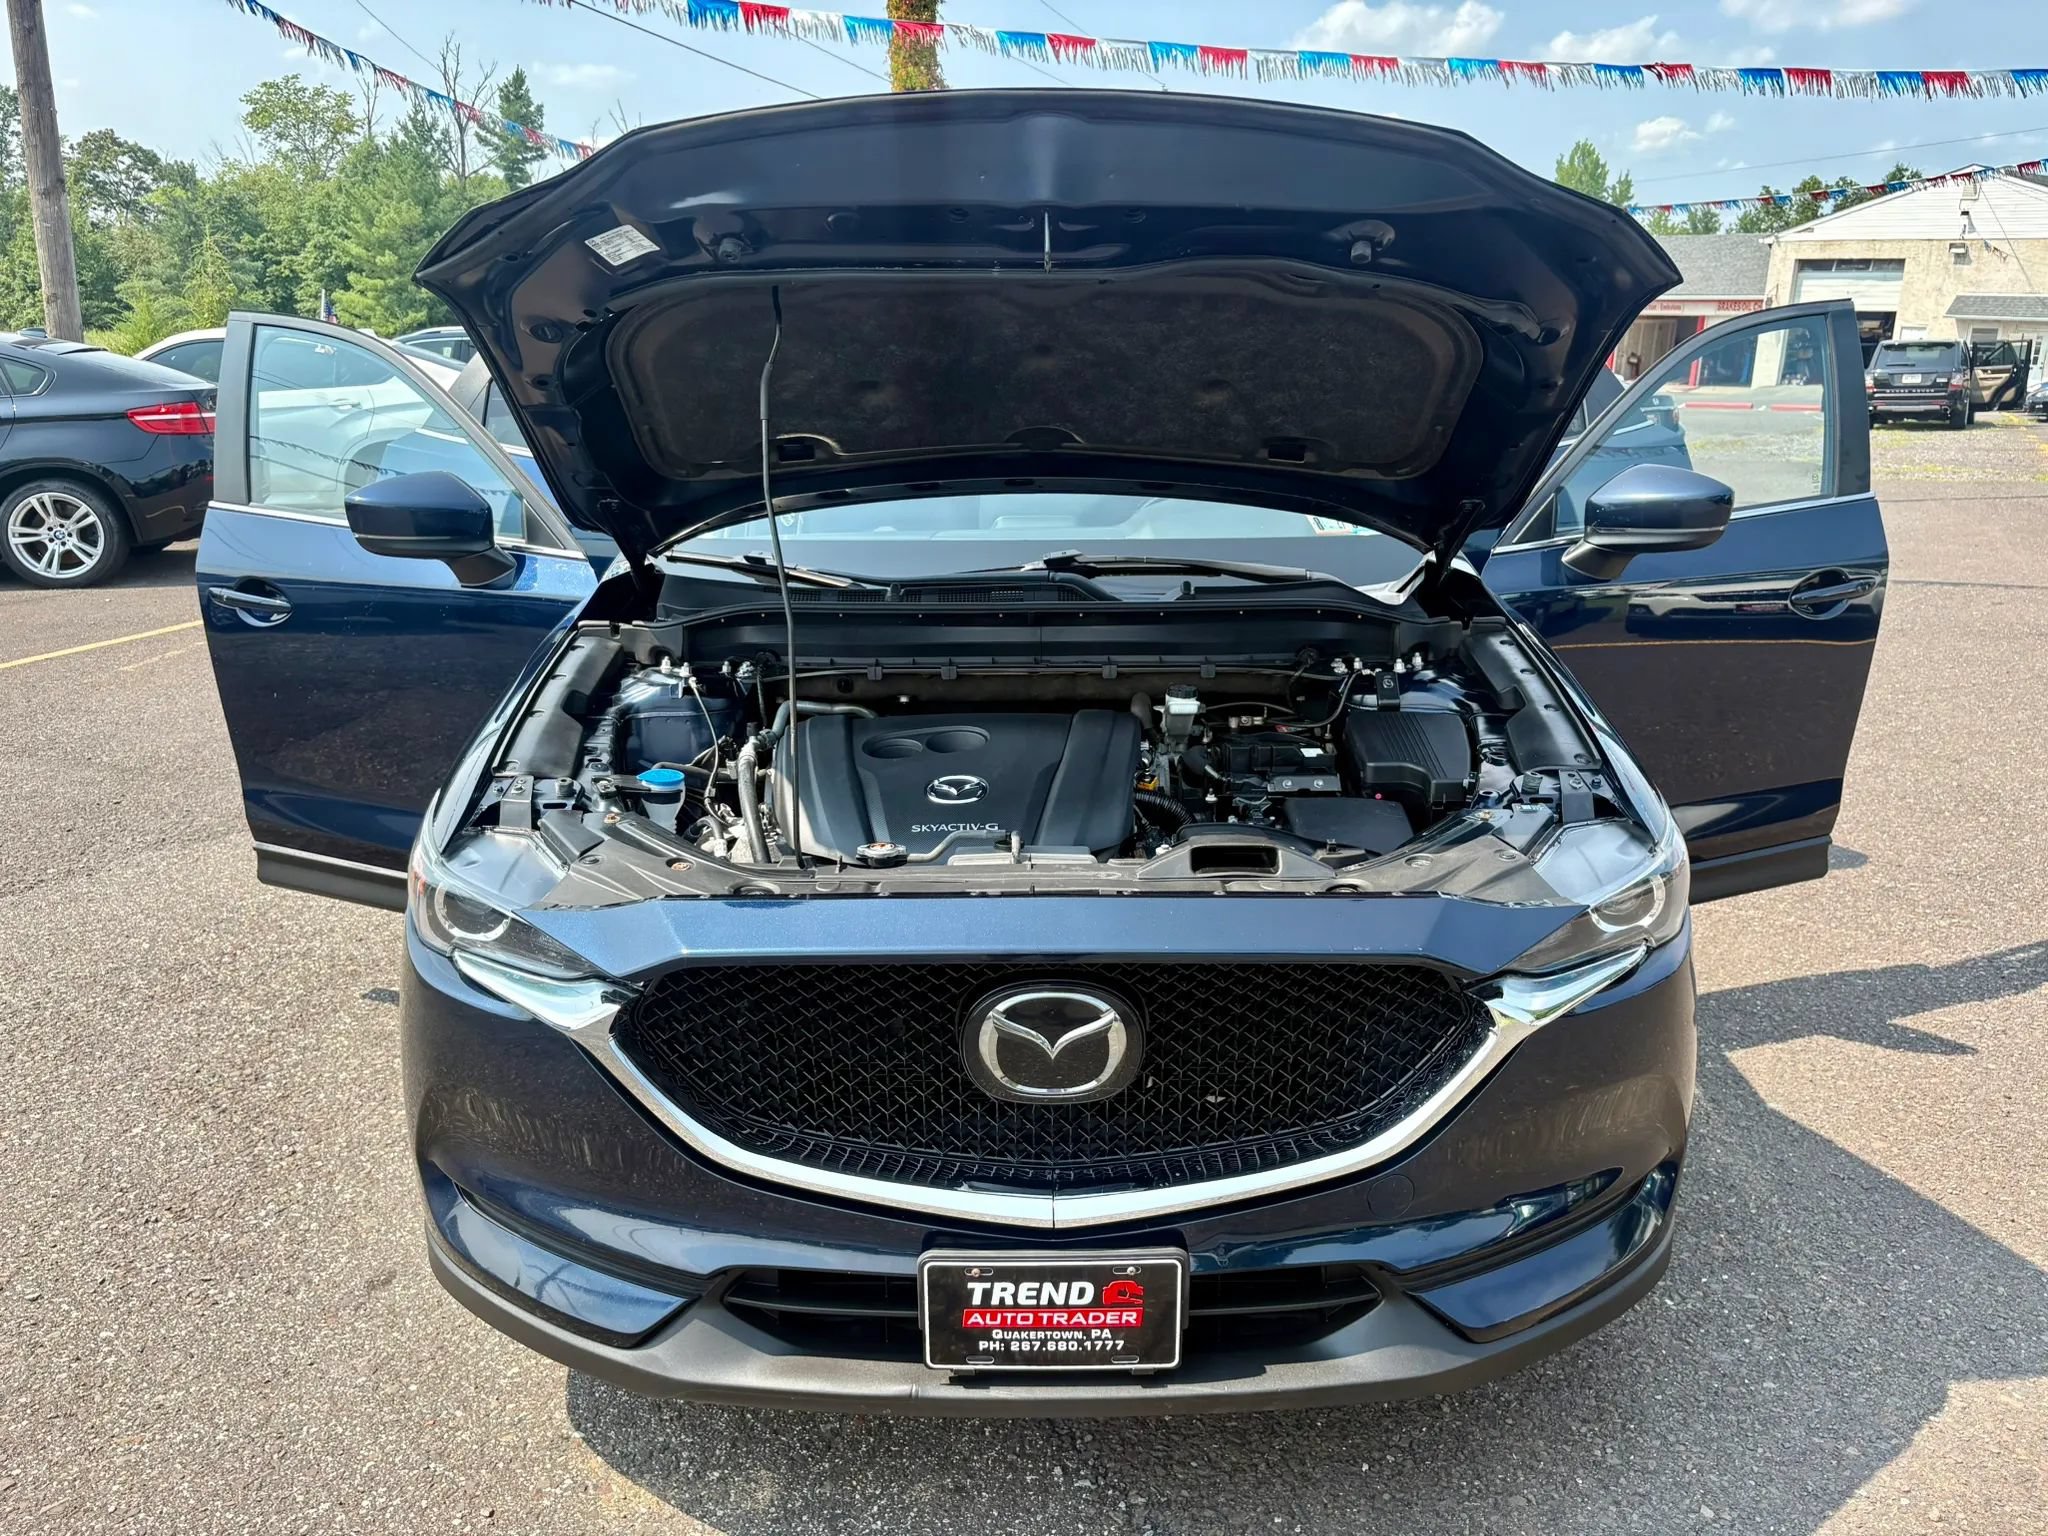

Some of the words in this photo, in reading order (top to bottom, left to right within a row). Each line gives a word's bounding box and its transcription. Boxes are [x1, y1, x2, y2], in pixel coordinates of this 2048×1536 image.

[911, 823, 999, 833] SKYACTIV-G
[966, 1281, 1095, 1306] TREND
[967, 1312, 1033, 1325] AUTO
[1037, 1311, 1138, 1325] TRADER
[1091, 1329, 1112, 1339] PA
[978, 1340, 1005, 1351] PH:
[1010, 1340, 1125, 1351] 267.680.1777
